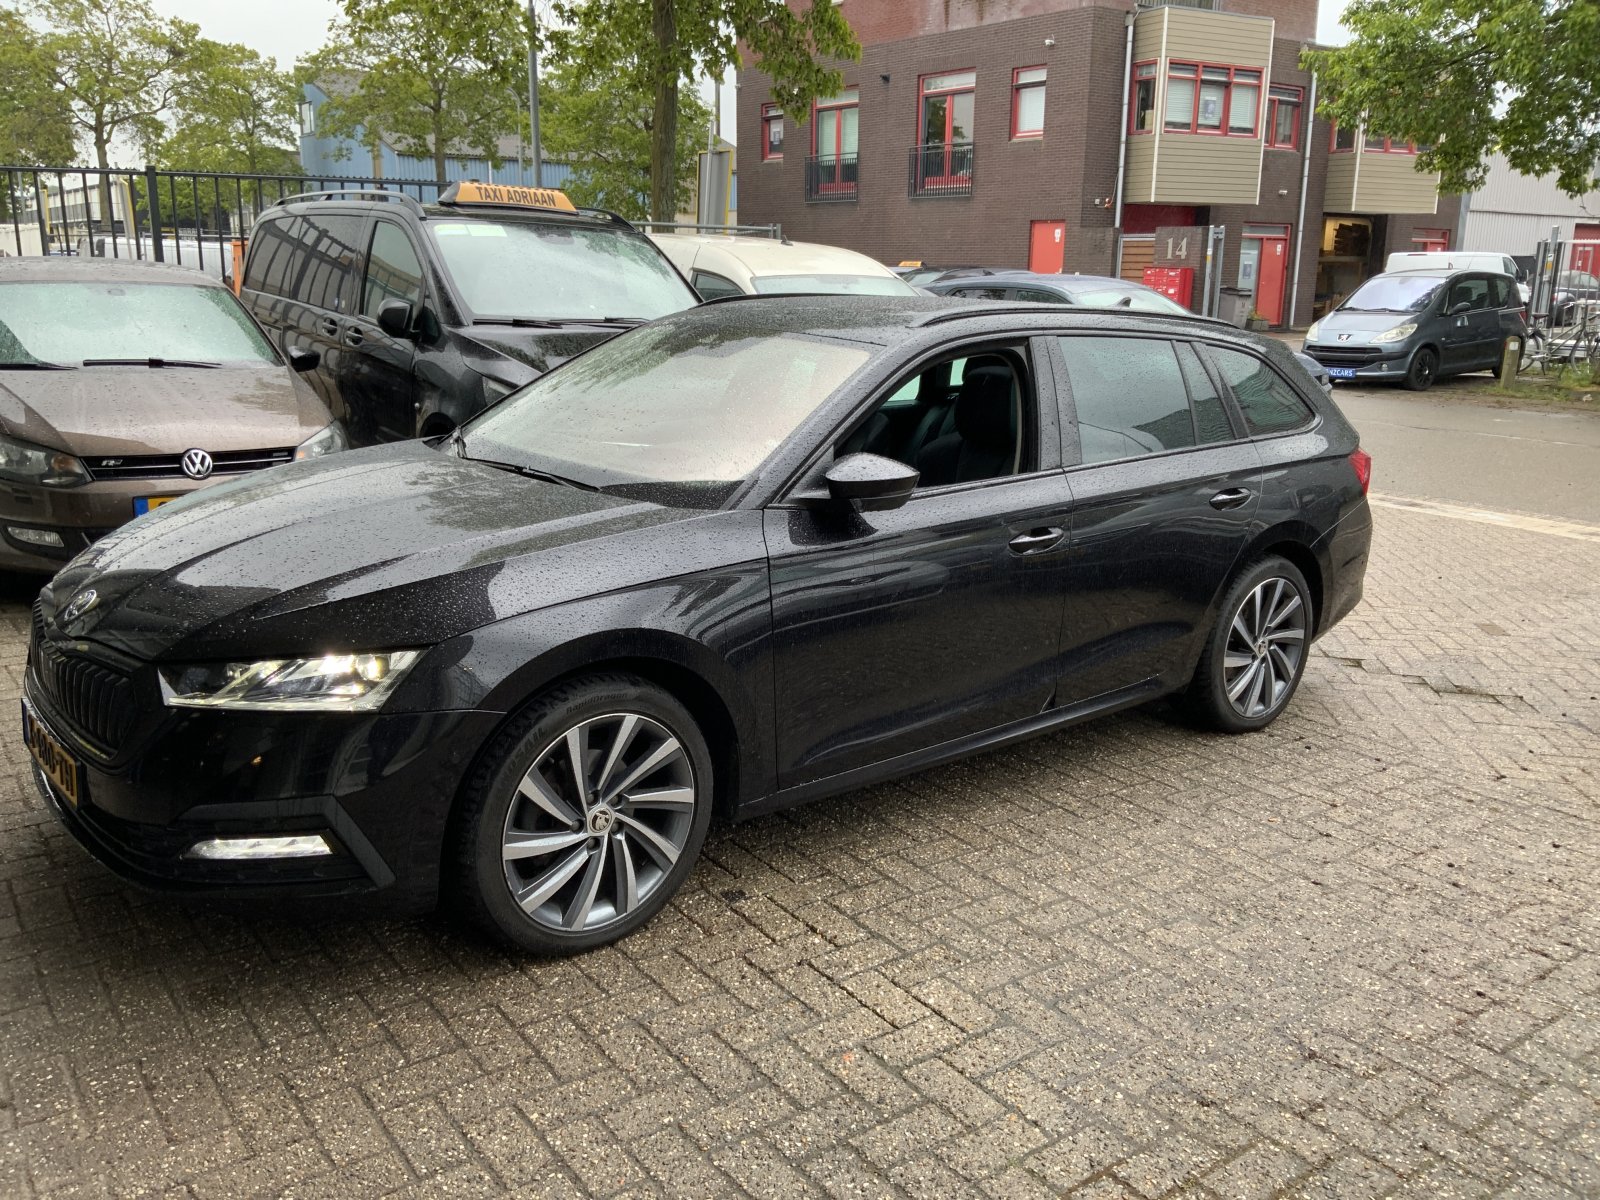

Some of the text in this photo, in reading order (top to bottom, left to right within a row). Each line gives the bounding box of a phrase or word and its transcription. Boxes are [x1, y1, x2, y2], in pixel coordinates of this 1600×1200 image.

[475, 186, 556, 207] TAXI ADRIAAN
[1166, 237, 1187, 260] 14
